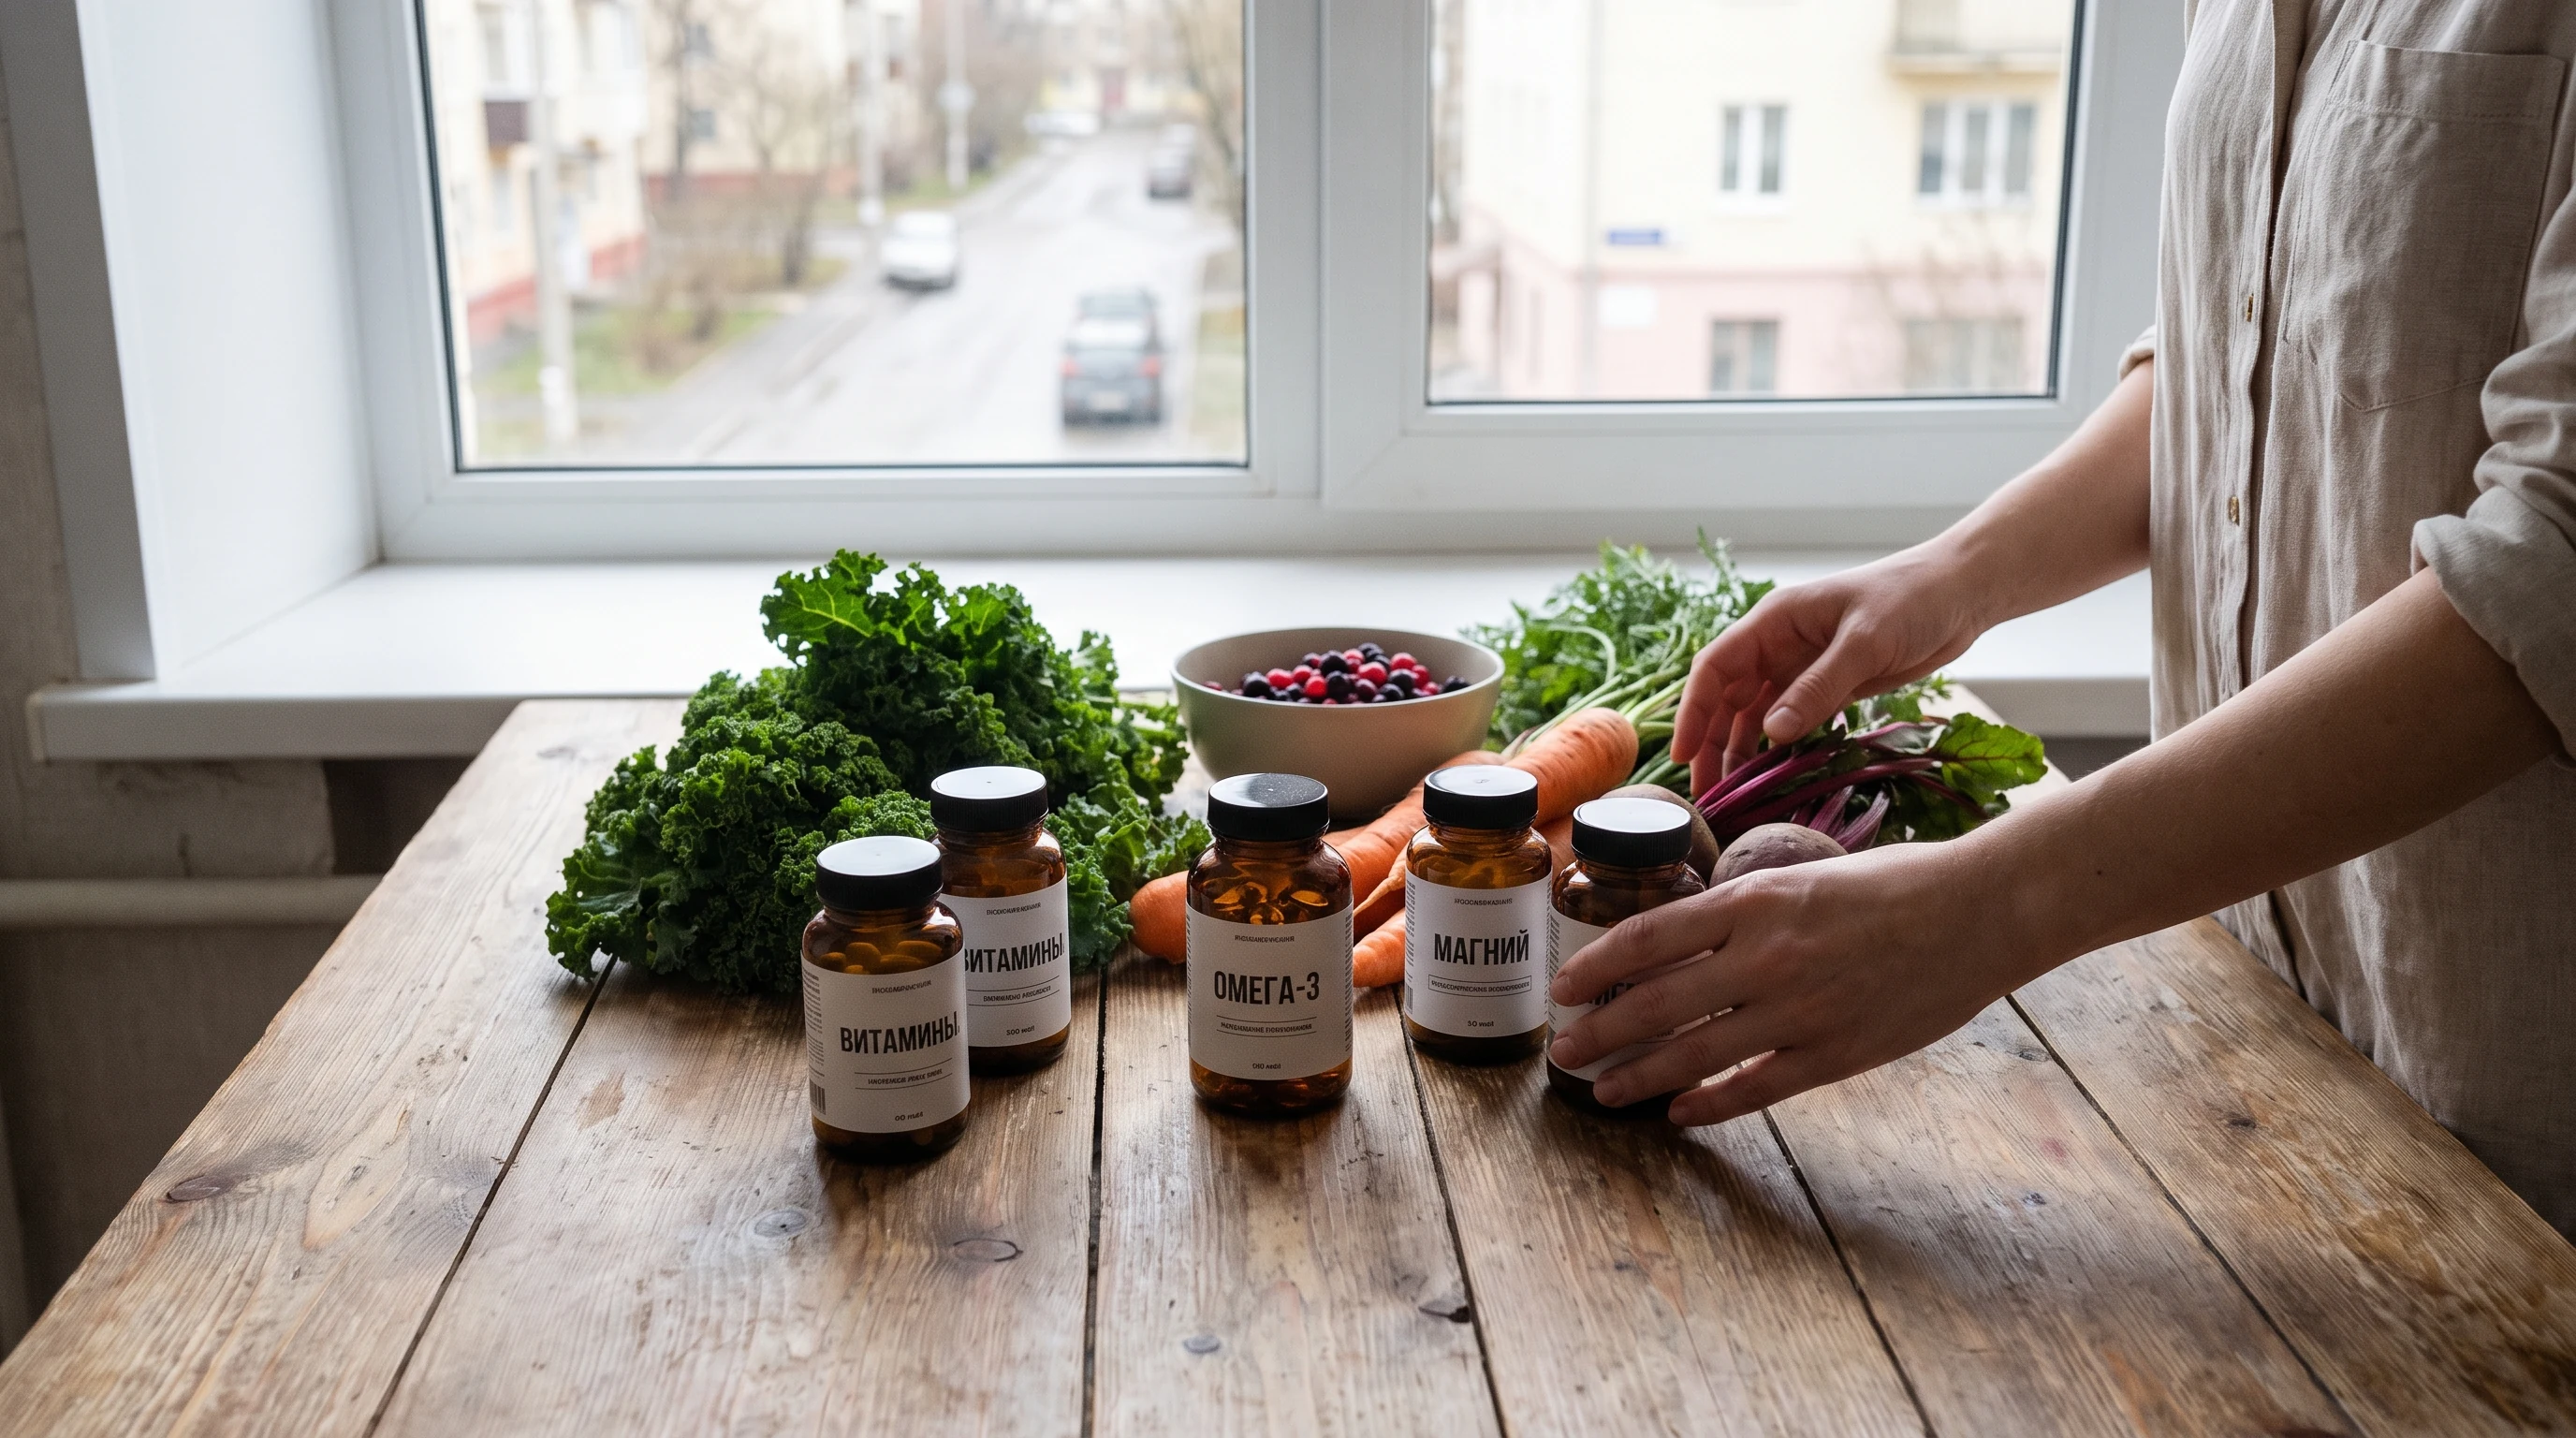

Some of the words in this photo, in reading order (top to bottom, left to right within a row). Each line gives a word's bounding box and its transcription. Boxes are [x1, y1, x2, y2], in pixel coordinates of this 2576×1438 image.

[1434, 929, 1530, 965] МАГНИЙ
[1214, 971, 1320, 1005] ОМЕГА-3
[840, 1011, 958, 1054] ВИТАМИНЫ
